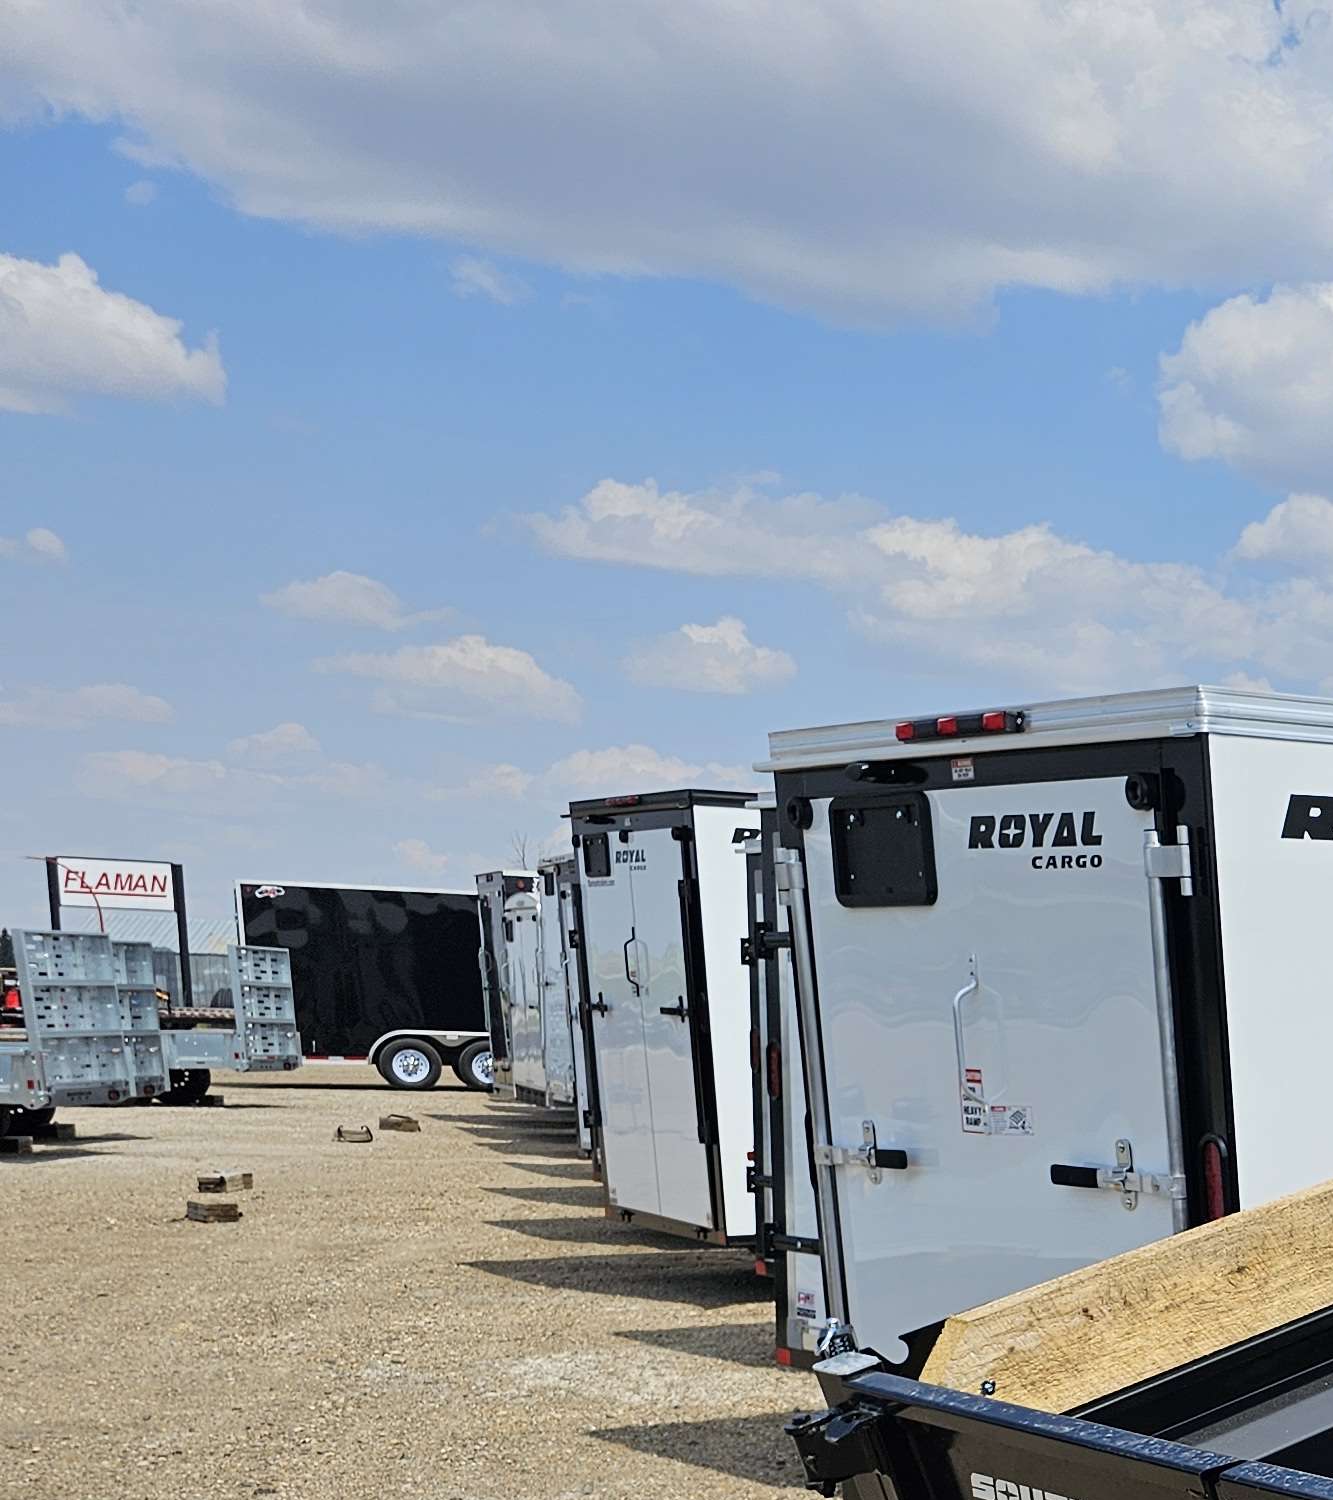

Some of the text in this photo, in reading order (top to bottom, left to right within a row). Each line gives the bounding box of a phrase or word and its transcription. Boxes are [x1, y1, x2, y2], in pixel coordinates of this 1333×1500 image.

[967, 811, 1103, 849] ROYAL
[615, 849, 646, 864] ROYAL
[1031, 854, 1103, 869] CARGO
[64, 870, 168, 893] FLAMAN
